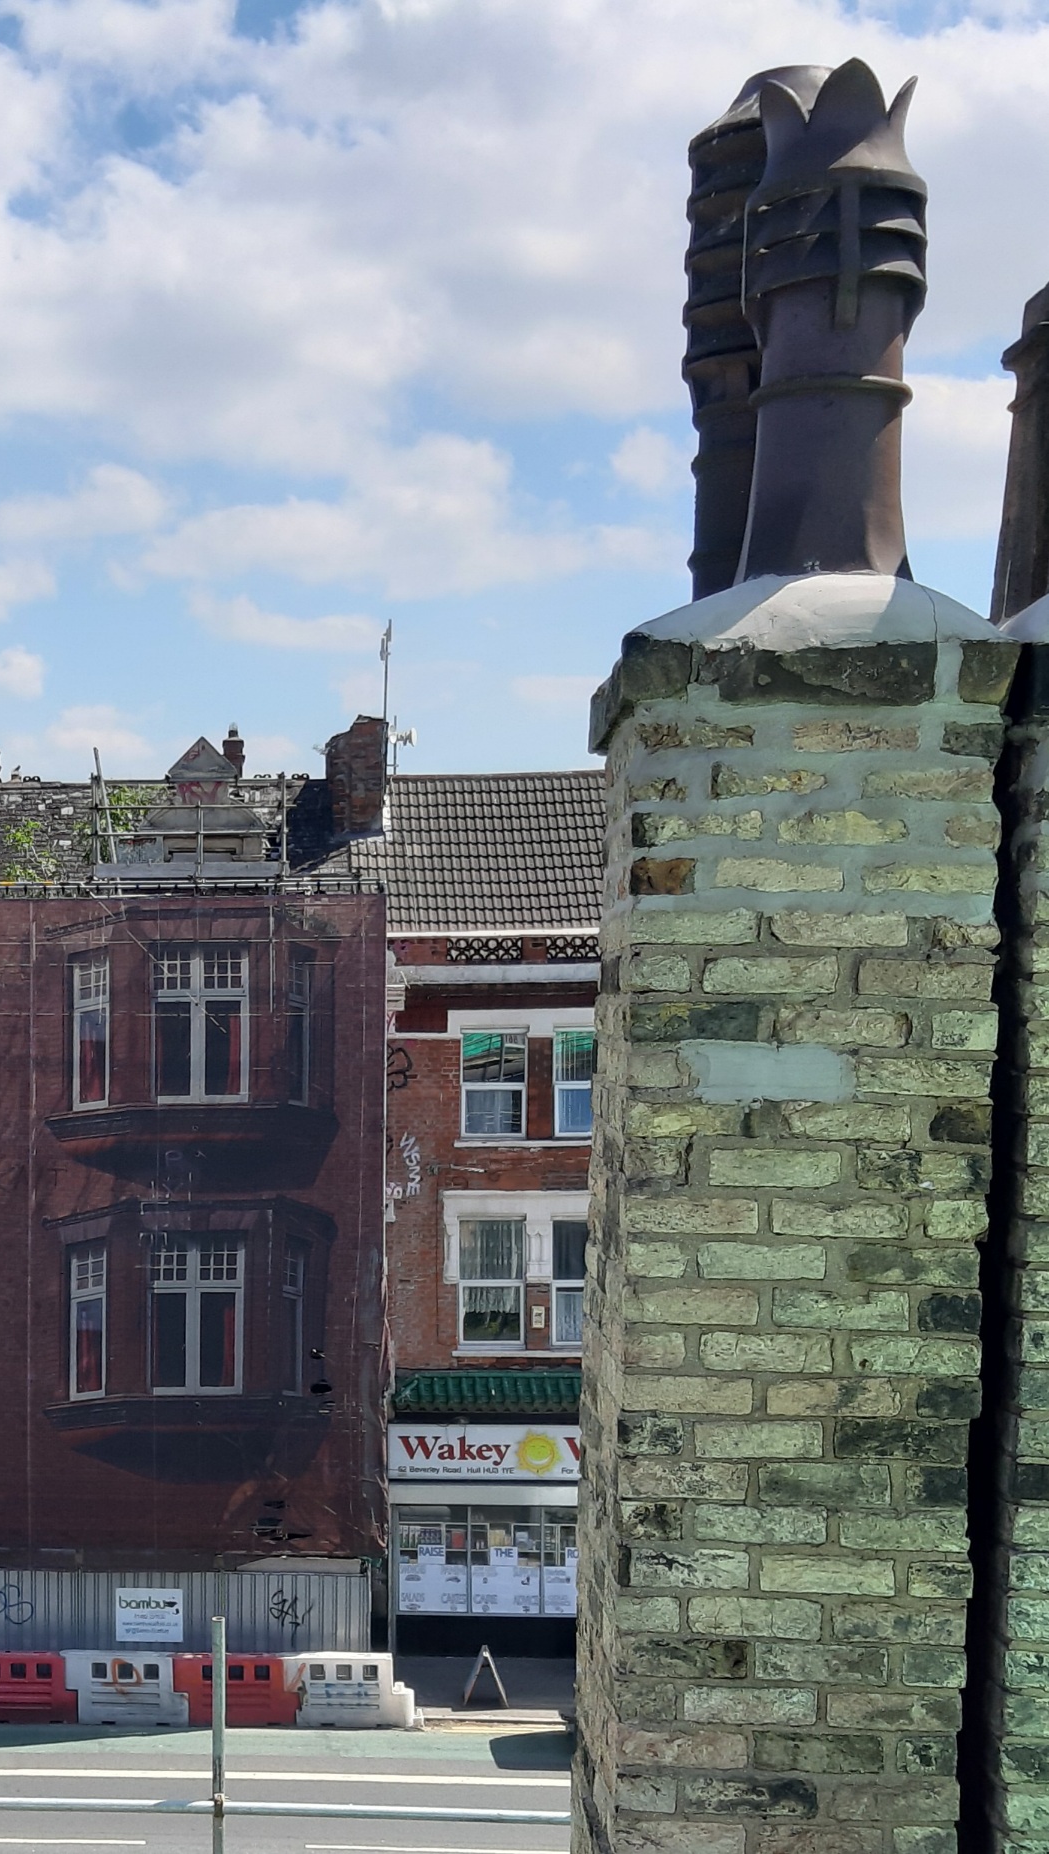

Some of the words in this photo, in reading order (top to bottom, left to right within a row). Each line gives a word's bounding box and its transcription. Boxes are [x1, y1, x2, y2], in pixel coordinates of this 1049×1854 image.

[398, 1433, 511, 1467] Wakey
[409, 1465, 440, 1475] Beverley
[442, 1466, 462, 1474] Road
[418, 1546, 445, 1557] RAISE
[494, 1548, 514, 1558] THE
[118, 1595, 166, 1609] bambu
